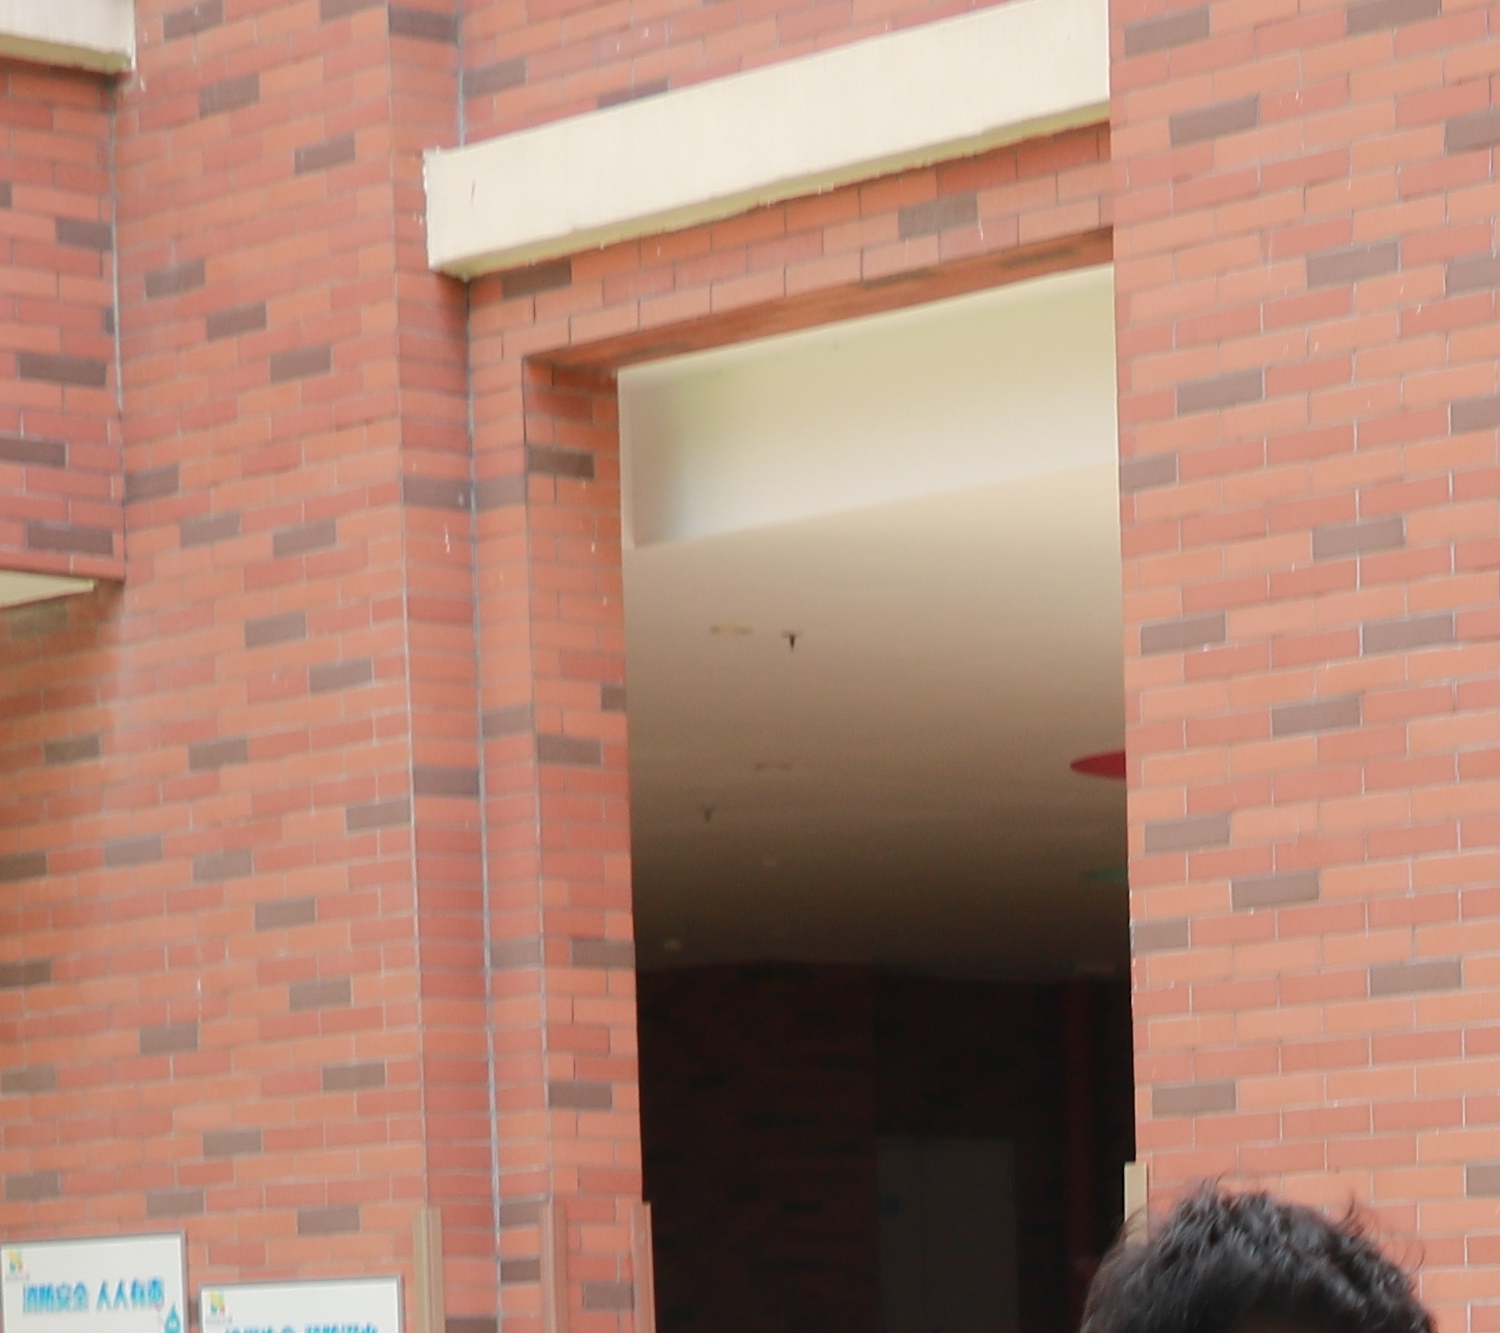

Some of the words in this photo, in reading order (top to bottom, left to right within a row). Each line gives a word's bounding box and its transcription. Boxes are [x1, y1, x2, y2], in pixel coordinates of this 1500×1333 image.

[23, 1281, 88, 1313] 消防安全
[96, 1277, 164, 1310] 人人有责
